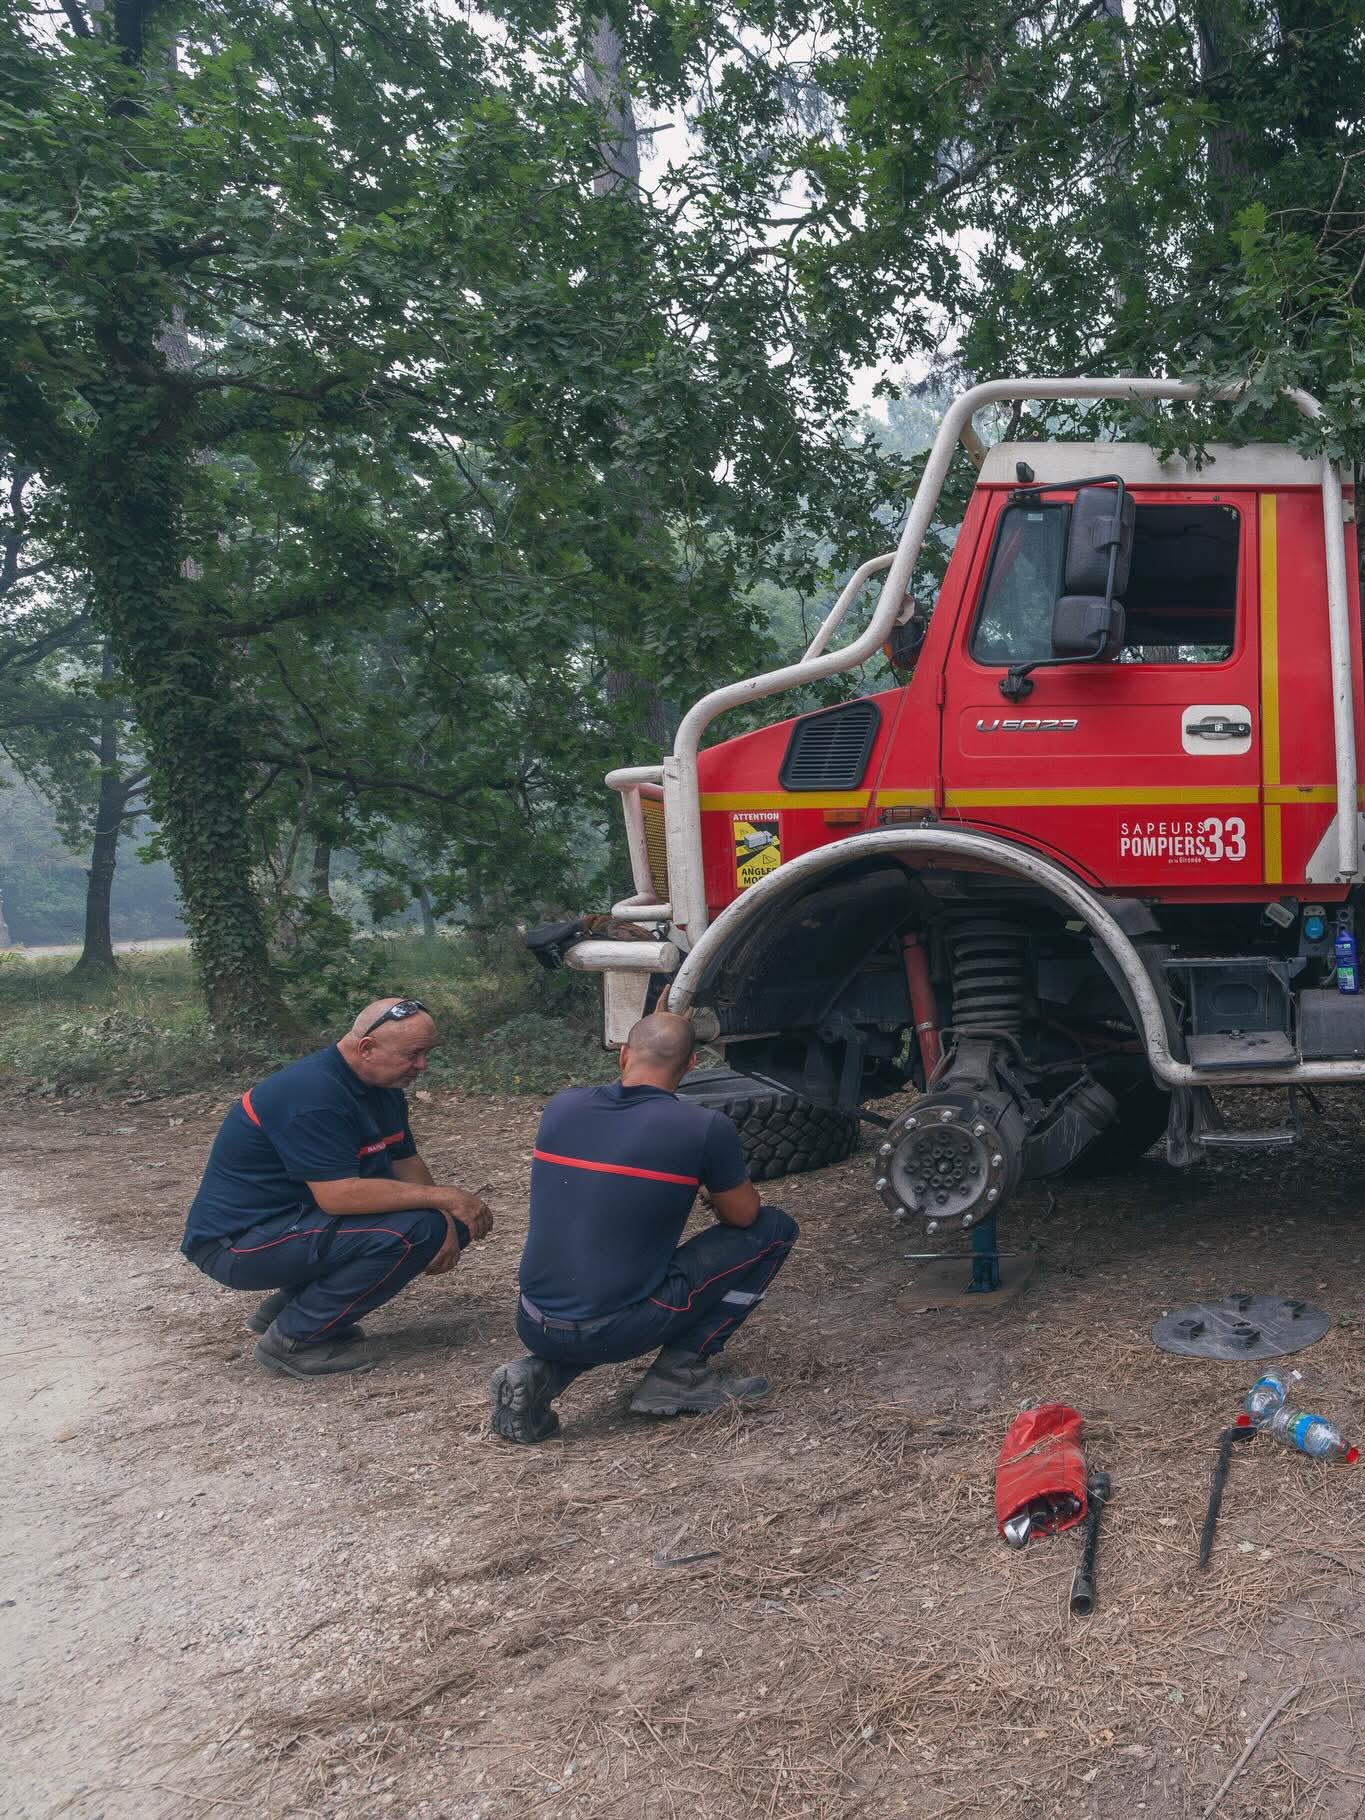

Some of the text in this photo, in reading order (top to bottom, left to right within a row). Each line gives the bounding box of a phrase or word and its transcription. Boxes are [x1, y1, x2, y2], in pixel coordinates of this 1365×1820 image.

[733, 812, 779, 821] ATTENTION
[1121, 822, 1205, 835] SAPEURS
[1120, 837, 1206, 857] POMPIERS
[1204, 817, 1246, 861] 33
